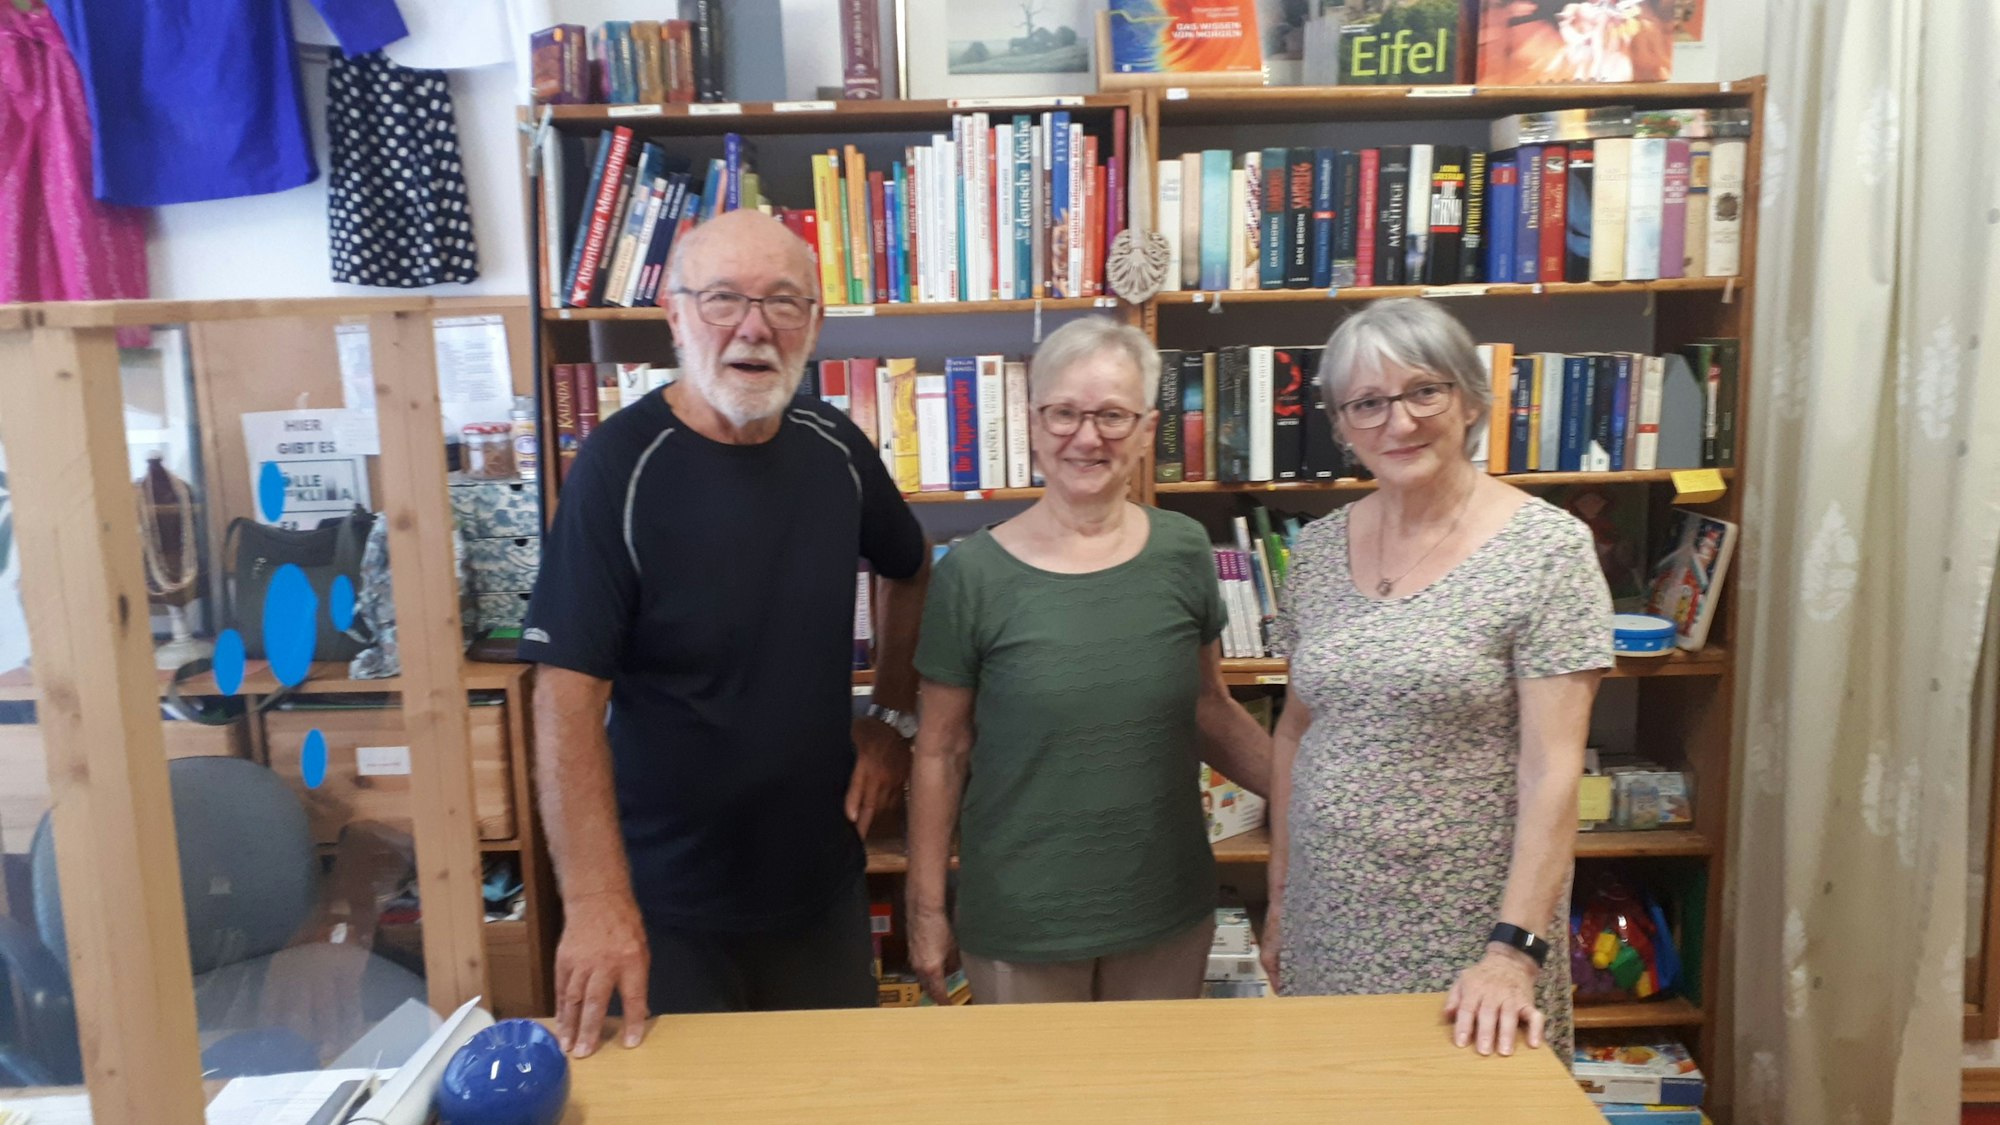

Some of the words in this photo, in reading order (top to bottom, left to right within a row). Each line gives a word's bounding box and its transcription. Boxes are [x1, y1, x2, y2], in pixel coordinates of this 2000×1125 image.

[1350, 28, 1448, 76] Eifel
[1013, 120, 1031, 164] Küche
[1469, 152, 1485, 196] CORNWELL
[577, 217, 606, 287] Abenteuer
[594, 134, 628, 214] Menschheit
[1013, 169, 1031, 228] deutsche
[1269, 216, 1279, 247] BROWN
[1295, 213, 1305, 245] BROWN
[1270, 249, 1279, 267] DAN
[1295, 246, 1305, 265] DAN
[557, 381, 574, 429] KALINDA
[284, 419, 322, 432] HIER
[277, 442, 314, 454] GIBT
[320, 441, 336, 453] ES
